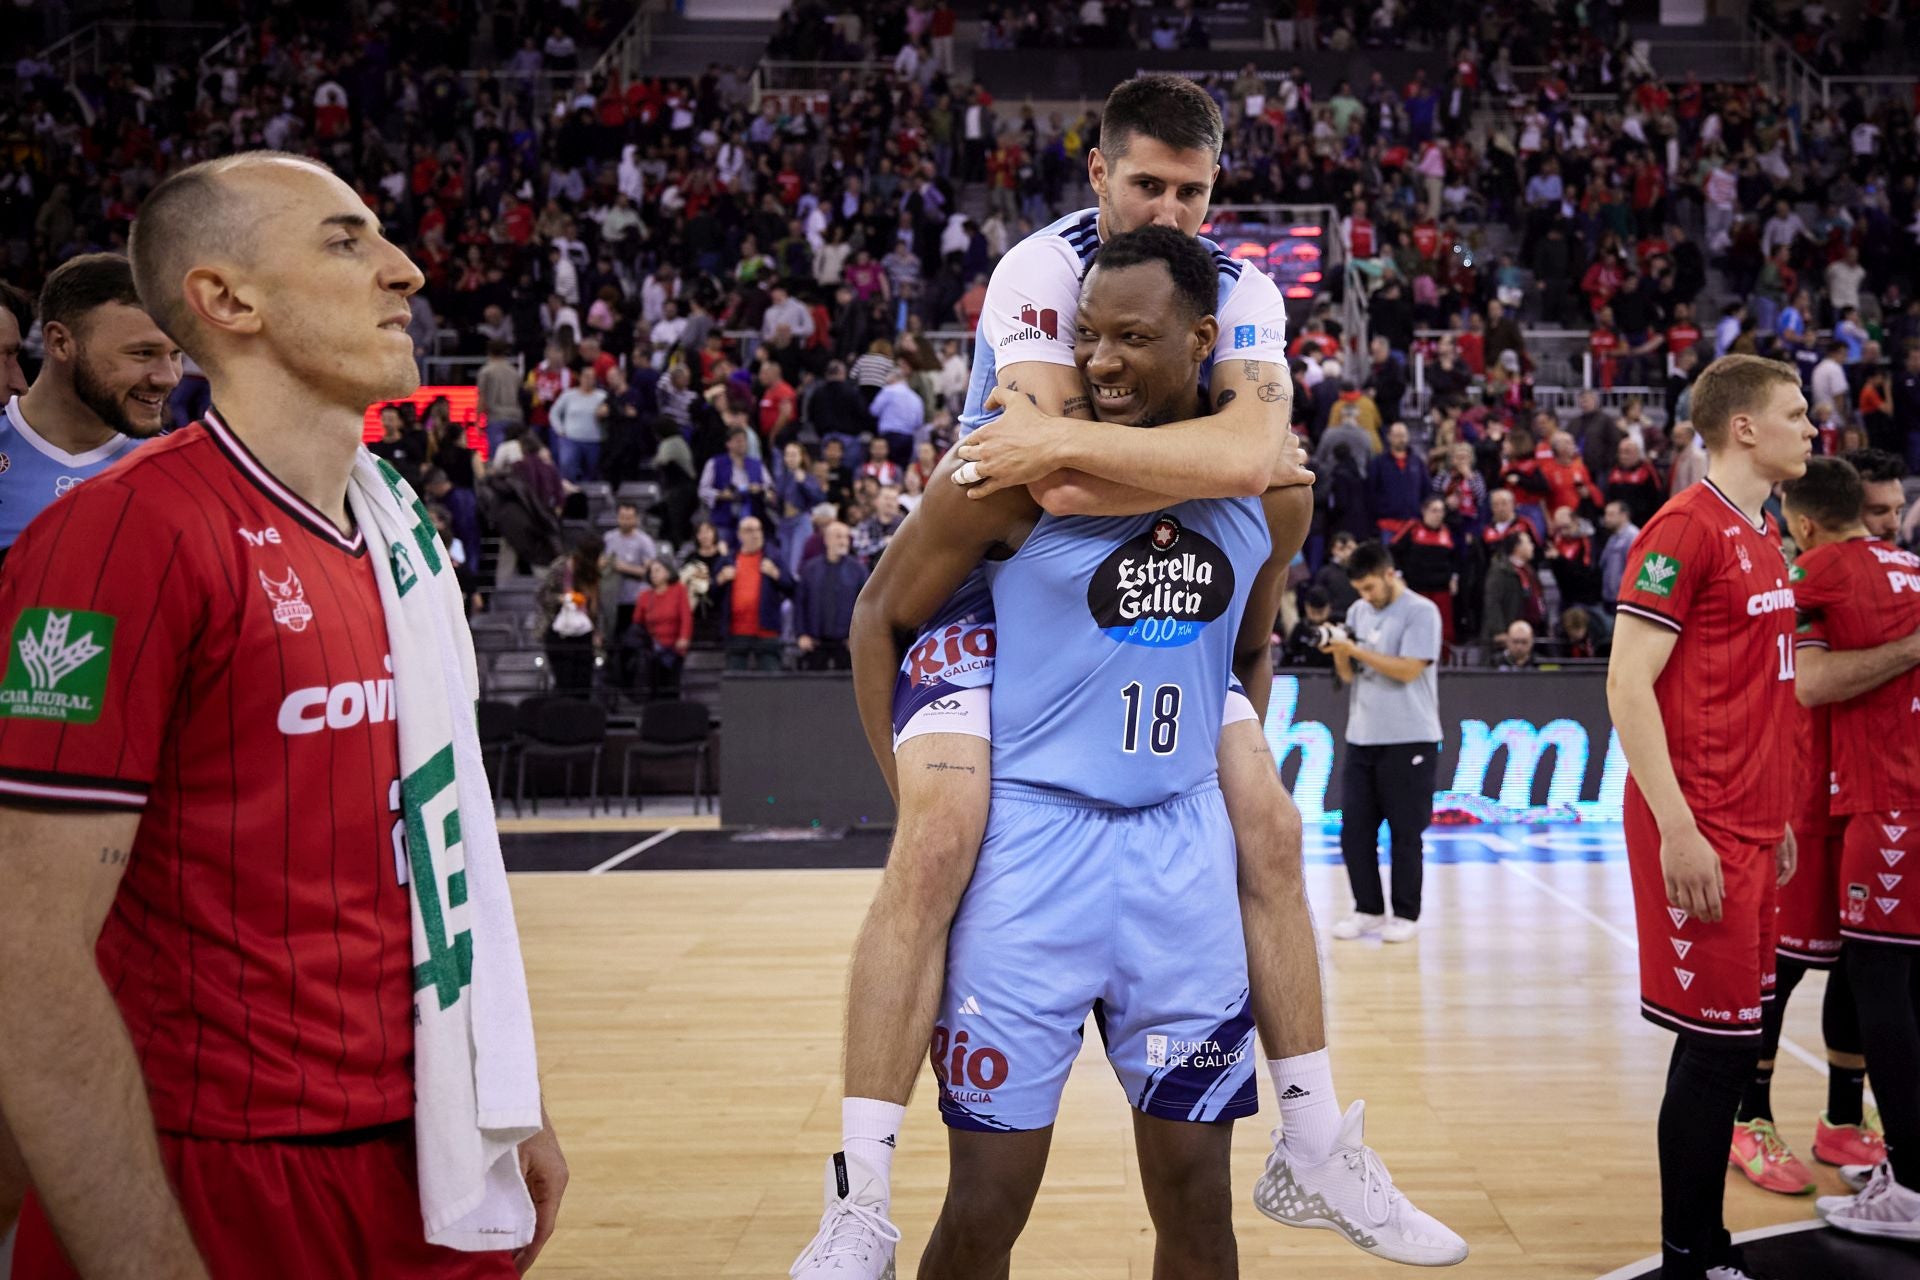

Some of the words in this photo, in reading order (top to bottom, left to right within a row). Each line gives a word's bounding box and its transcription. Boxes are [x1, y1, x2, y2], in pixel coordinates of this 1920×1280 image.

[1117, 553, 1213, 590] Estrella
[1141, 616, 1177, 643] 0,0
[943, 659, 990, 678] GALICIA
[32, 691, 94, 710] RURAL
[11, 705, 67, 718] GRANADA
[1120, 680, 1183, 756] 18
[1700, 1006, 1732, 1021] vive
[1171, 1040, 1221, 1054] XUNTA
[1170, 1054, 1189, 1068] DE
[1193, 1051, 1246, 1068] GALICIA
